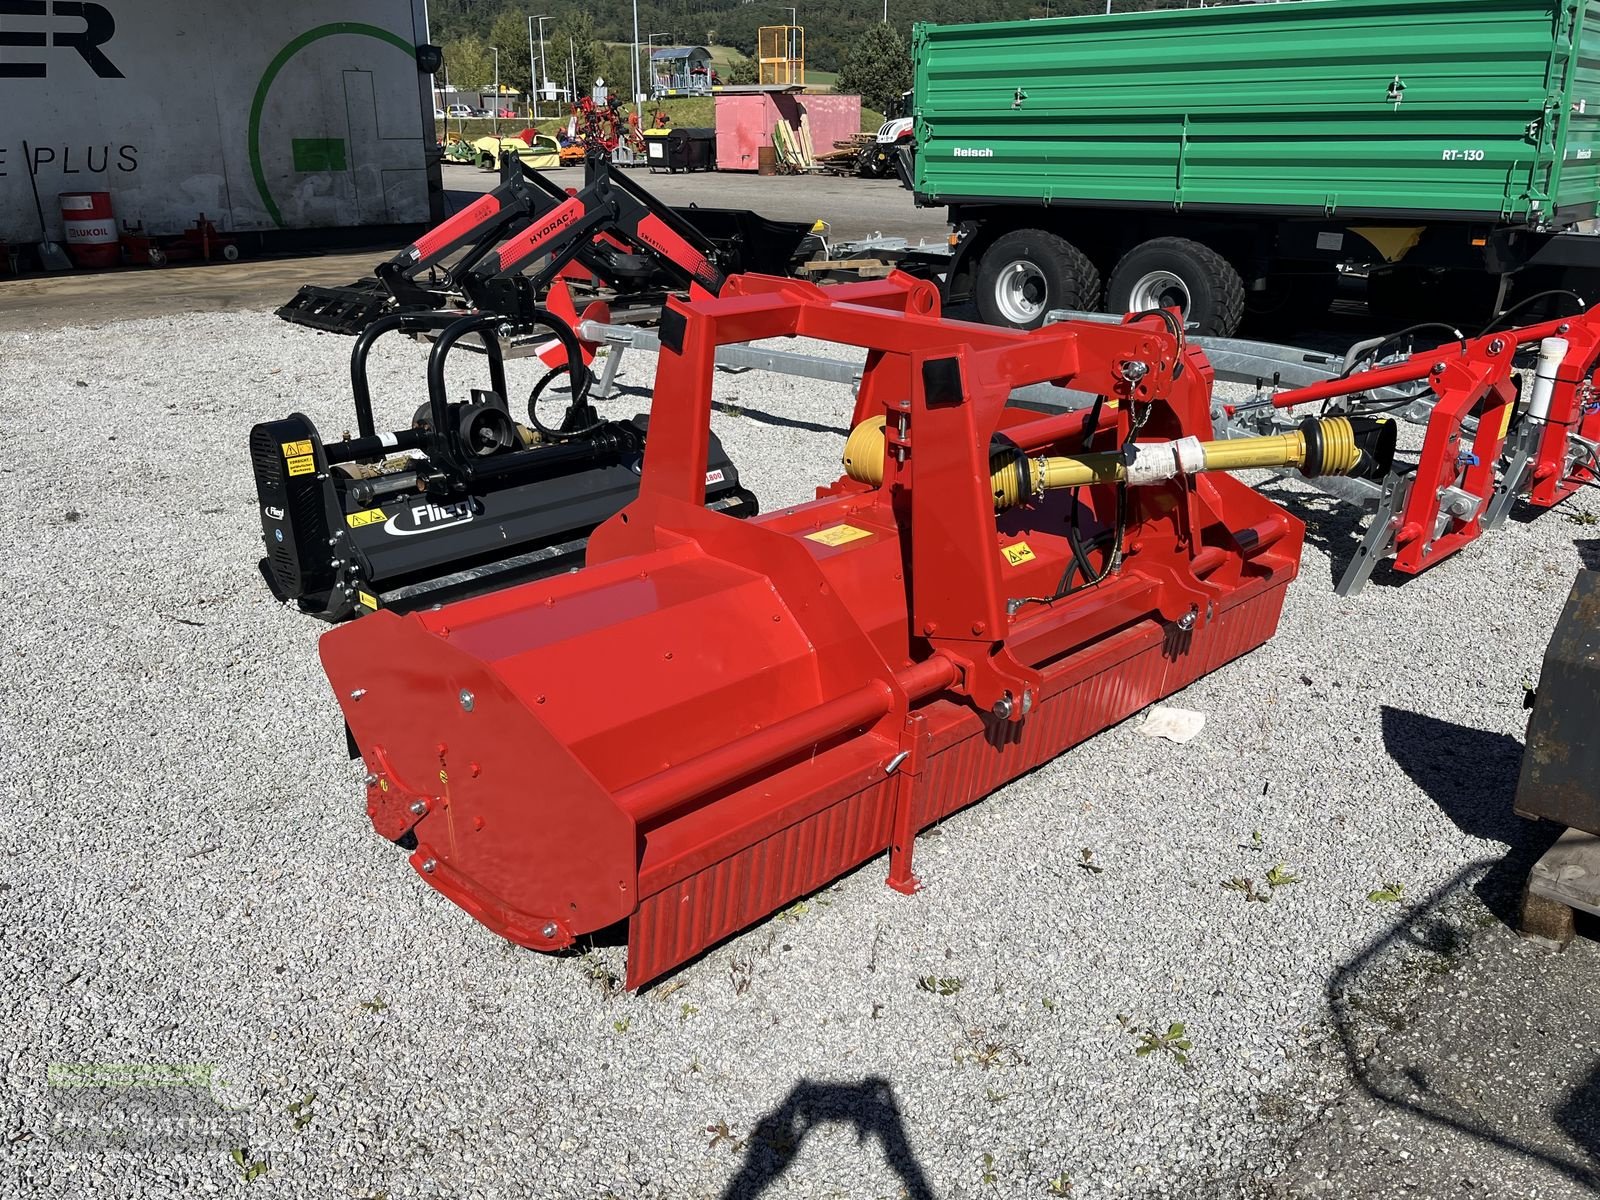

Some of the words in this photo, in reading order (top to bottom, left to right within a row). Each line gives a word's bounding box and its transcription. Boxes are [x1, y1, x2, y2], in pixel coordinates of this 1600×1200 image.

[953, 147, 994, 158] Reisch
[1442, 150, 1484, 161] RT-130
[33, 145, 138, 174] PLUS
[76, 228, 108, 237] LUKOIL
[529, 213, 571, 245] HYDRAC
